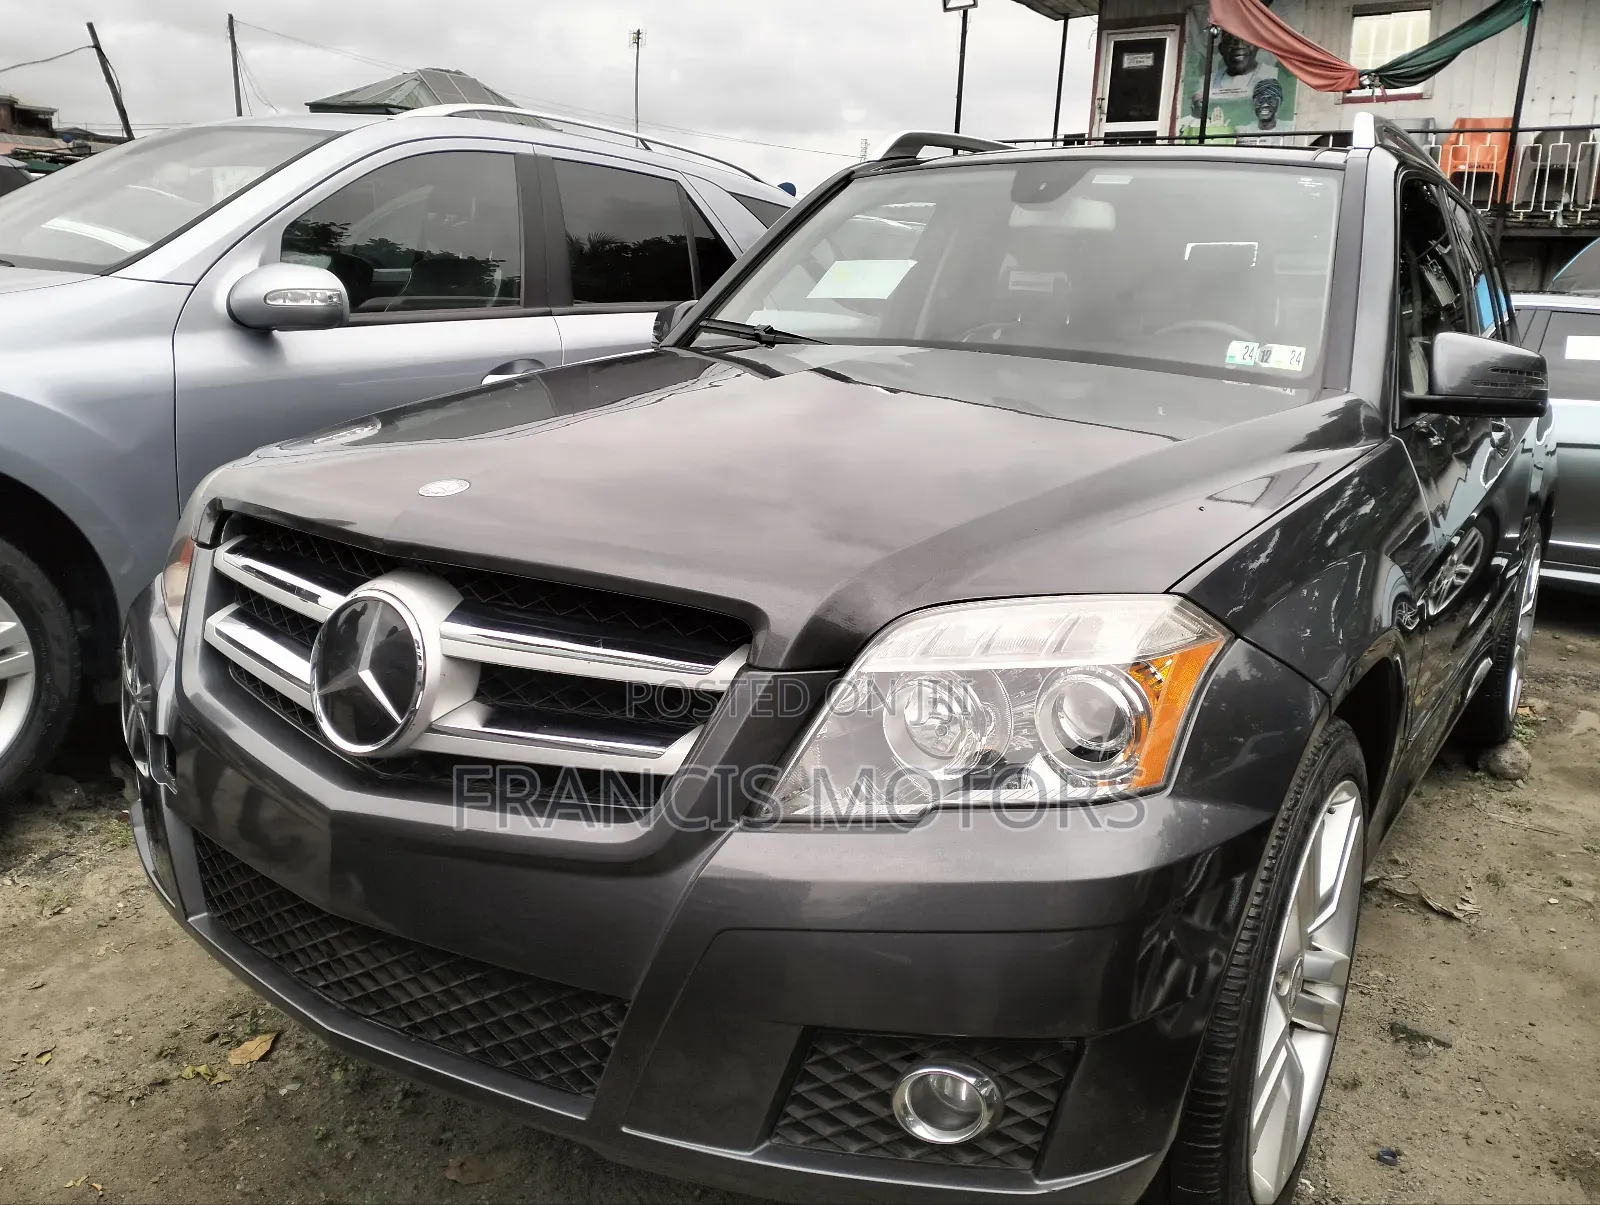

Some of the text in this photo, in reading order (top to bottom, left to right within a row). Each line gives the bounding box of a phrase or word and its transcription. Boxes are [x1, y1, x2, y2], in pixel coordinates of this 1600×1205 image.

[1242, 345, 1255, 361] 24
[1260, 349, 1302, 366] 12 24
